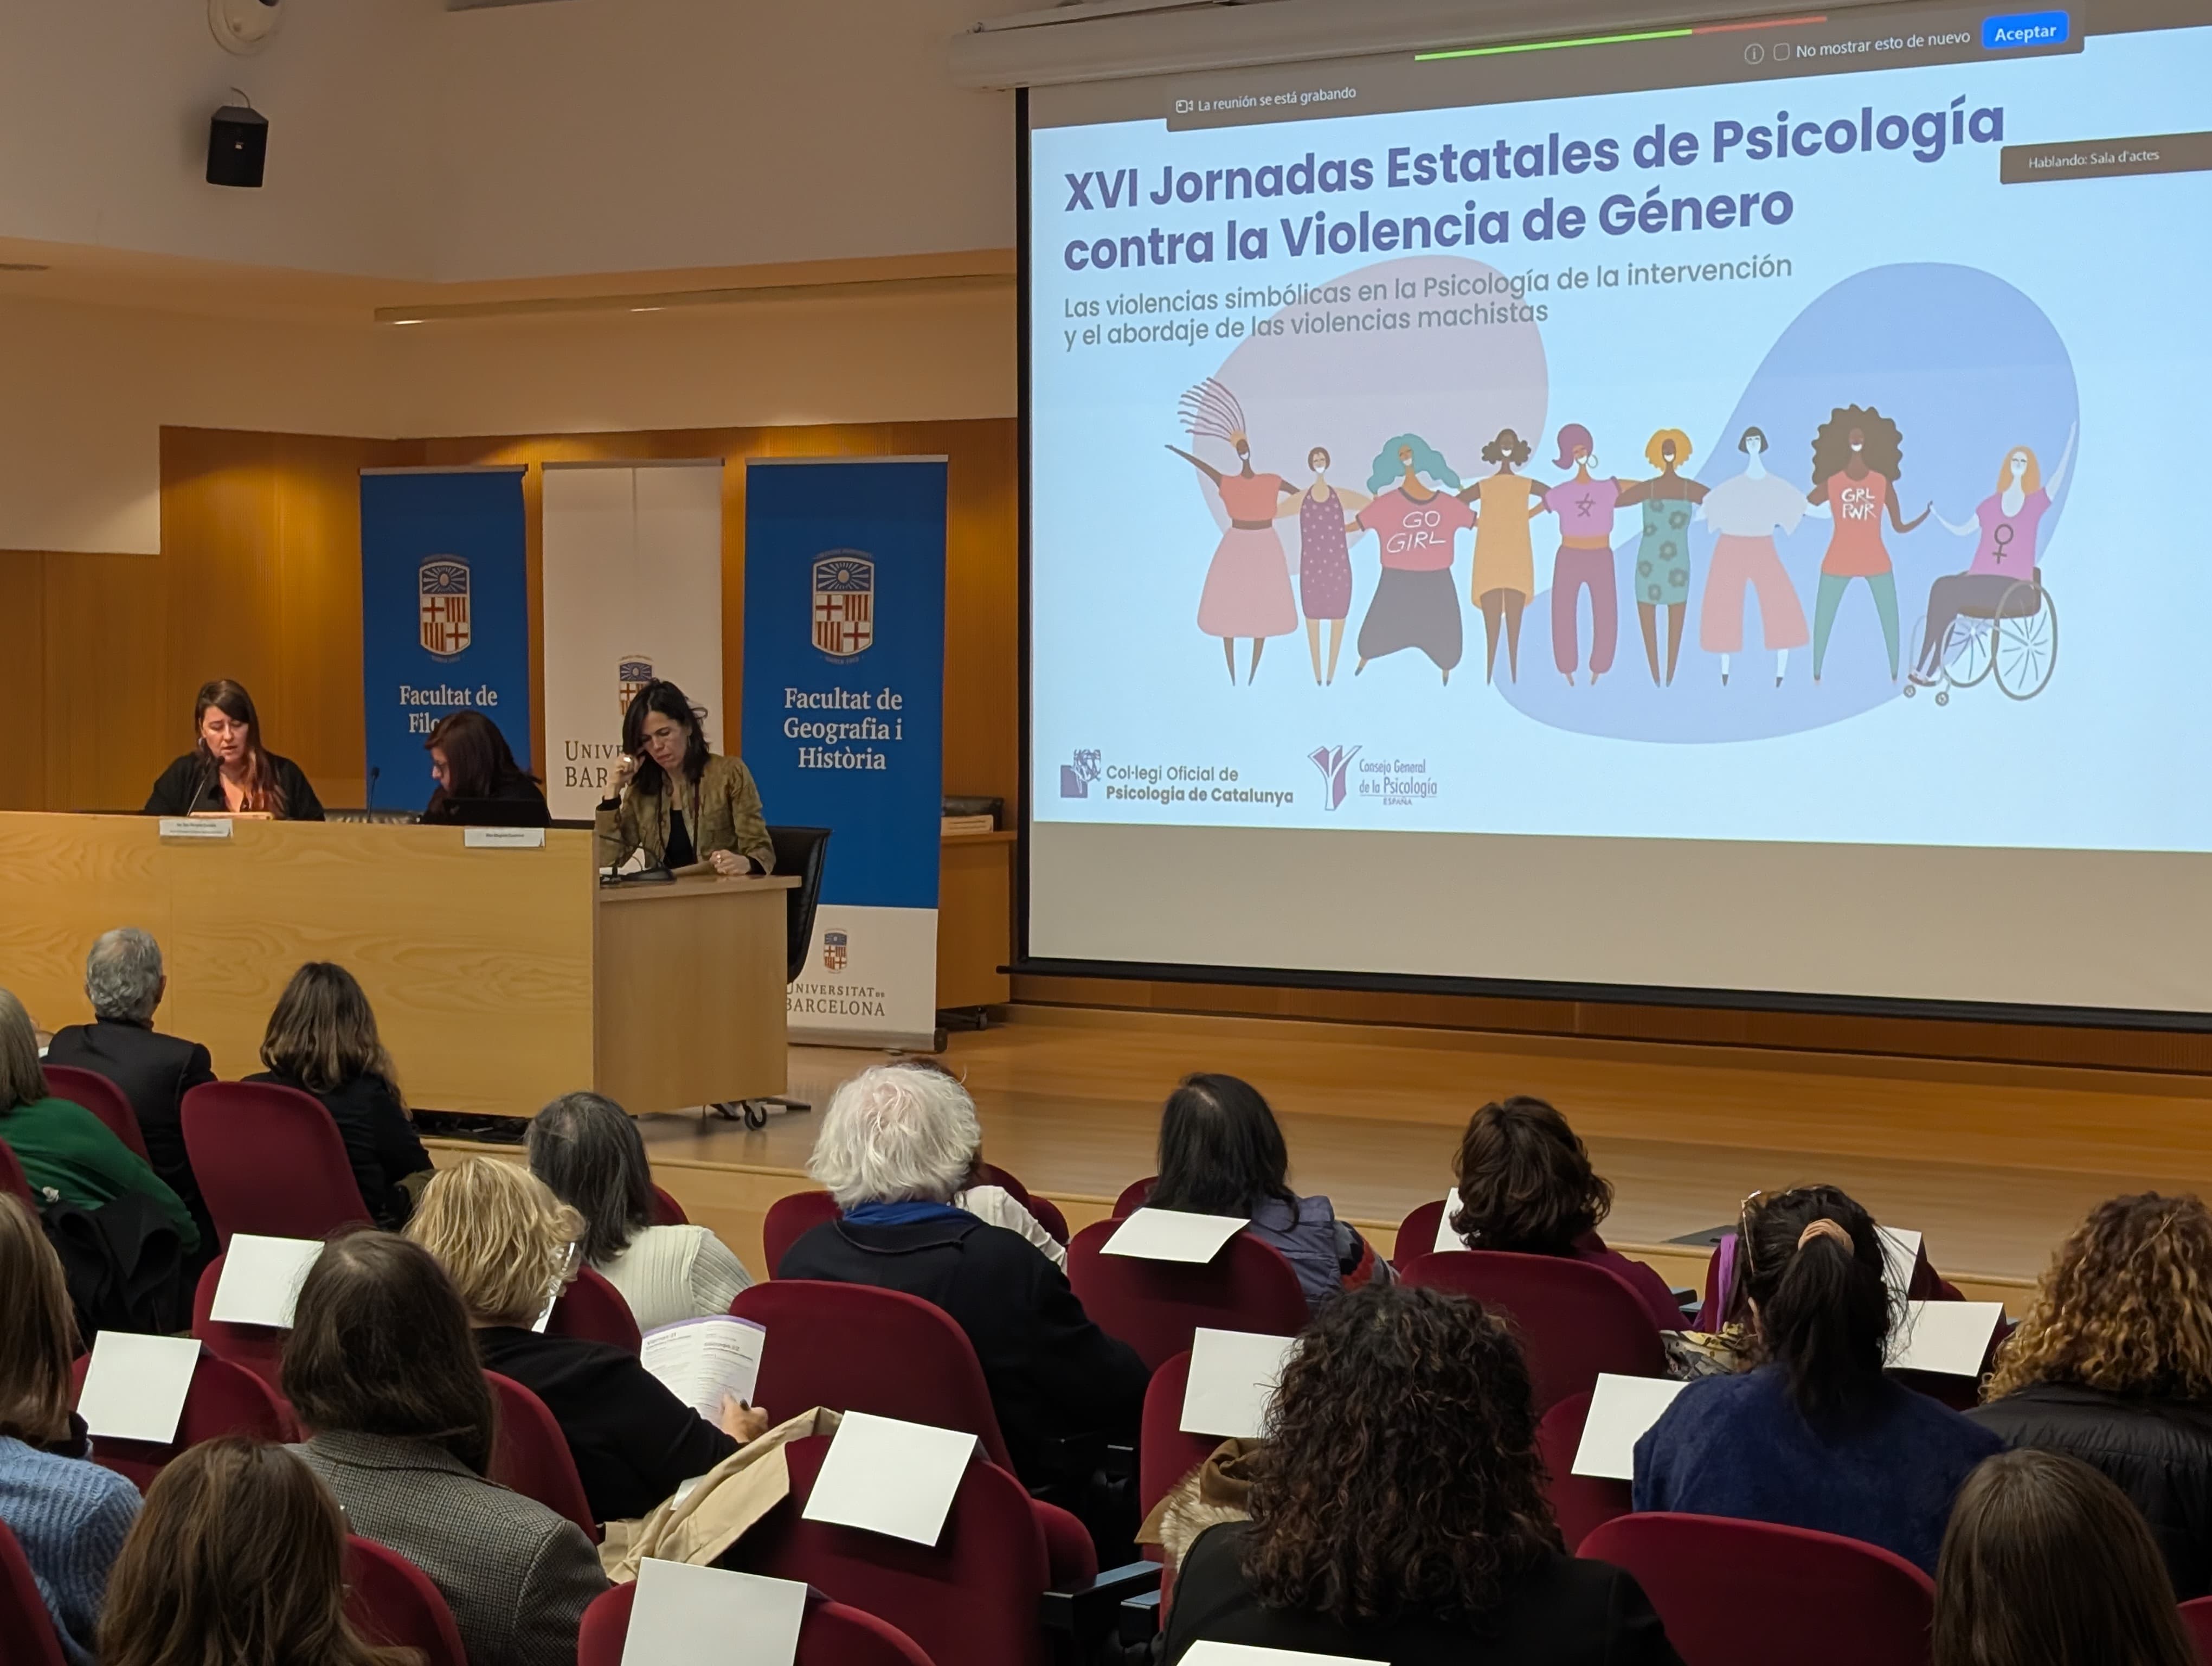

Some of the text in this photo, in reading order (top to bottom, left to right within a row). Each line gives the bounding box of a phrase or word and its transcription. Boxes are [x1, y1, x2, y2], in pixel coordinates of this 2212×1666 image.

[1797, 31, 1971, 58] No mostrar esto de nuevo
[1995, 24, 2057, 43] Aceptar
[1198, 87, 1356, 112] La reunión se está grabando
[1064, 94, 2004, 212] XVI Jornadas Estatales de Psicología
[2028, 153, 2087, 168] Hablando:
[2090, 152, 2115, 164] Sala
[1064, 185, 1794, 271] contra la Violencia de Género
[1065, 254, 1792, 319] Las violencias simbólicas en la Psicología de la intervención
[1064, 301, 1549, 351] y el abordaje de las violencias machistas
[1842, 488, 1875, 502] GRL
[1403, 511, 1440, 528] GO
[1843, 503, 1876, 521] PWR
[1386, 531, 1446, 553] GIRL
[400, 684, 498, 706] Facultat de
[784, 687, 903, 710] Facultat de
[784, 717, 903, 744] Geografia i
[799, 747, 886, 770] Història
[1360, 759, 1426, 774] Consejo General
[1167, 766, 1214, 781] Oficial
[1219, 767, 1238, 781] de
[1107, 785, 1293, 807] Psicologia de Catalunya
[1359, 777, 1437, 798] de la Psicología
[1383, 797, 1412, 805] ESPAÑA
